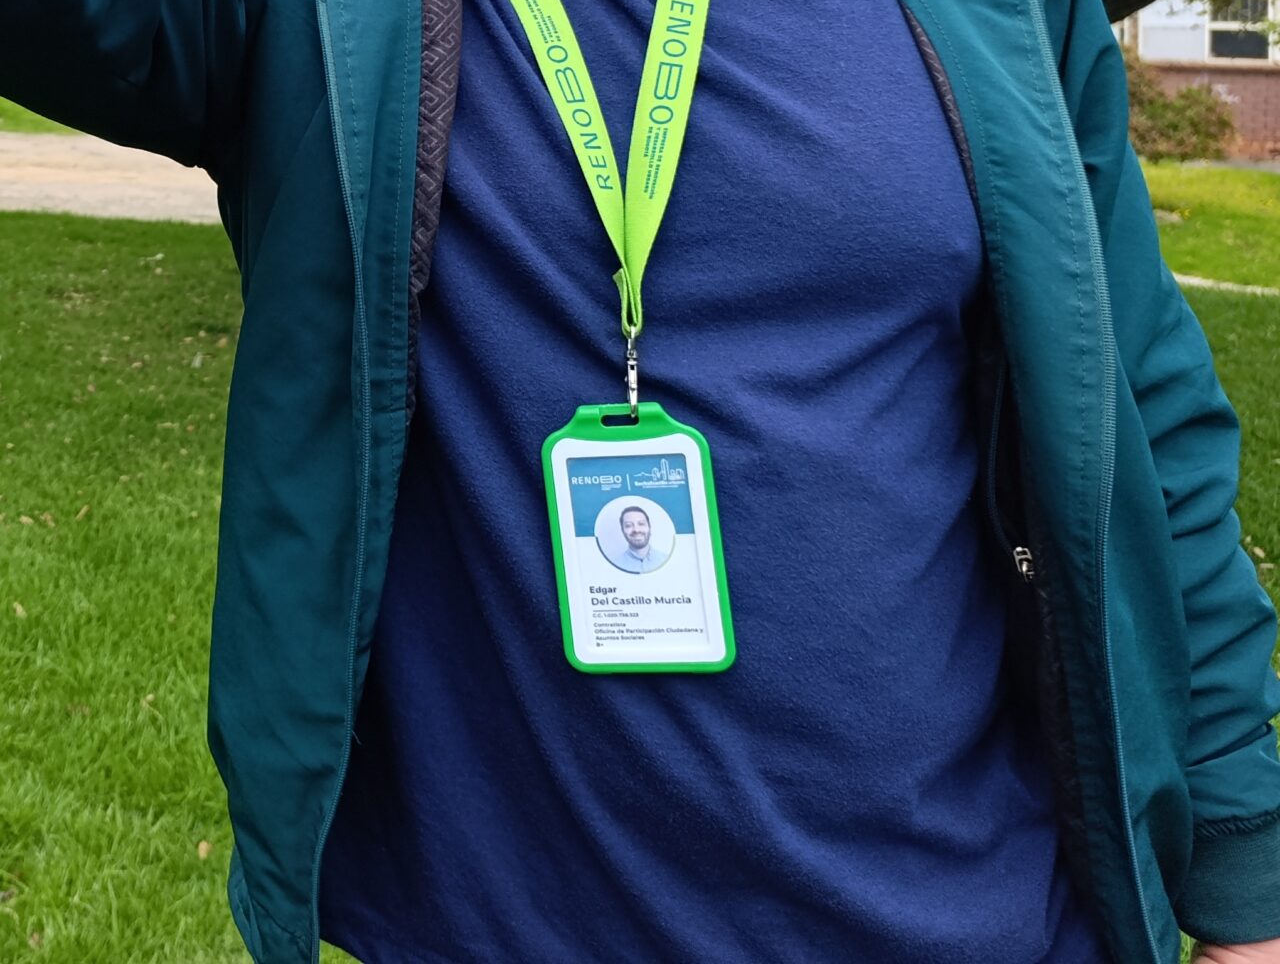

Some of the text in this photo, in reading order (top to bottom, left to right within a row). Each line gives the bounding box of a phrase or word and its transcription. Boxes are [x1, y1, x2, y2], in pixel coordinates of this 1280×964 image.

[546, 44, 614, 190] RENOBO
[571, 475, 622, 485] RENOBO
[589, 586, 617, 595] Edgar
[591, 594, 692, 606] Del Castillo Murcia
